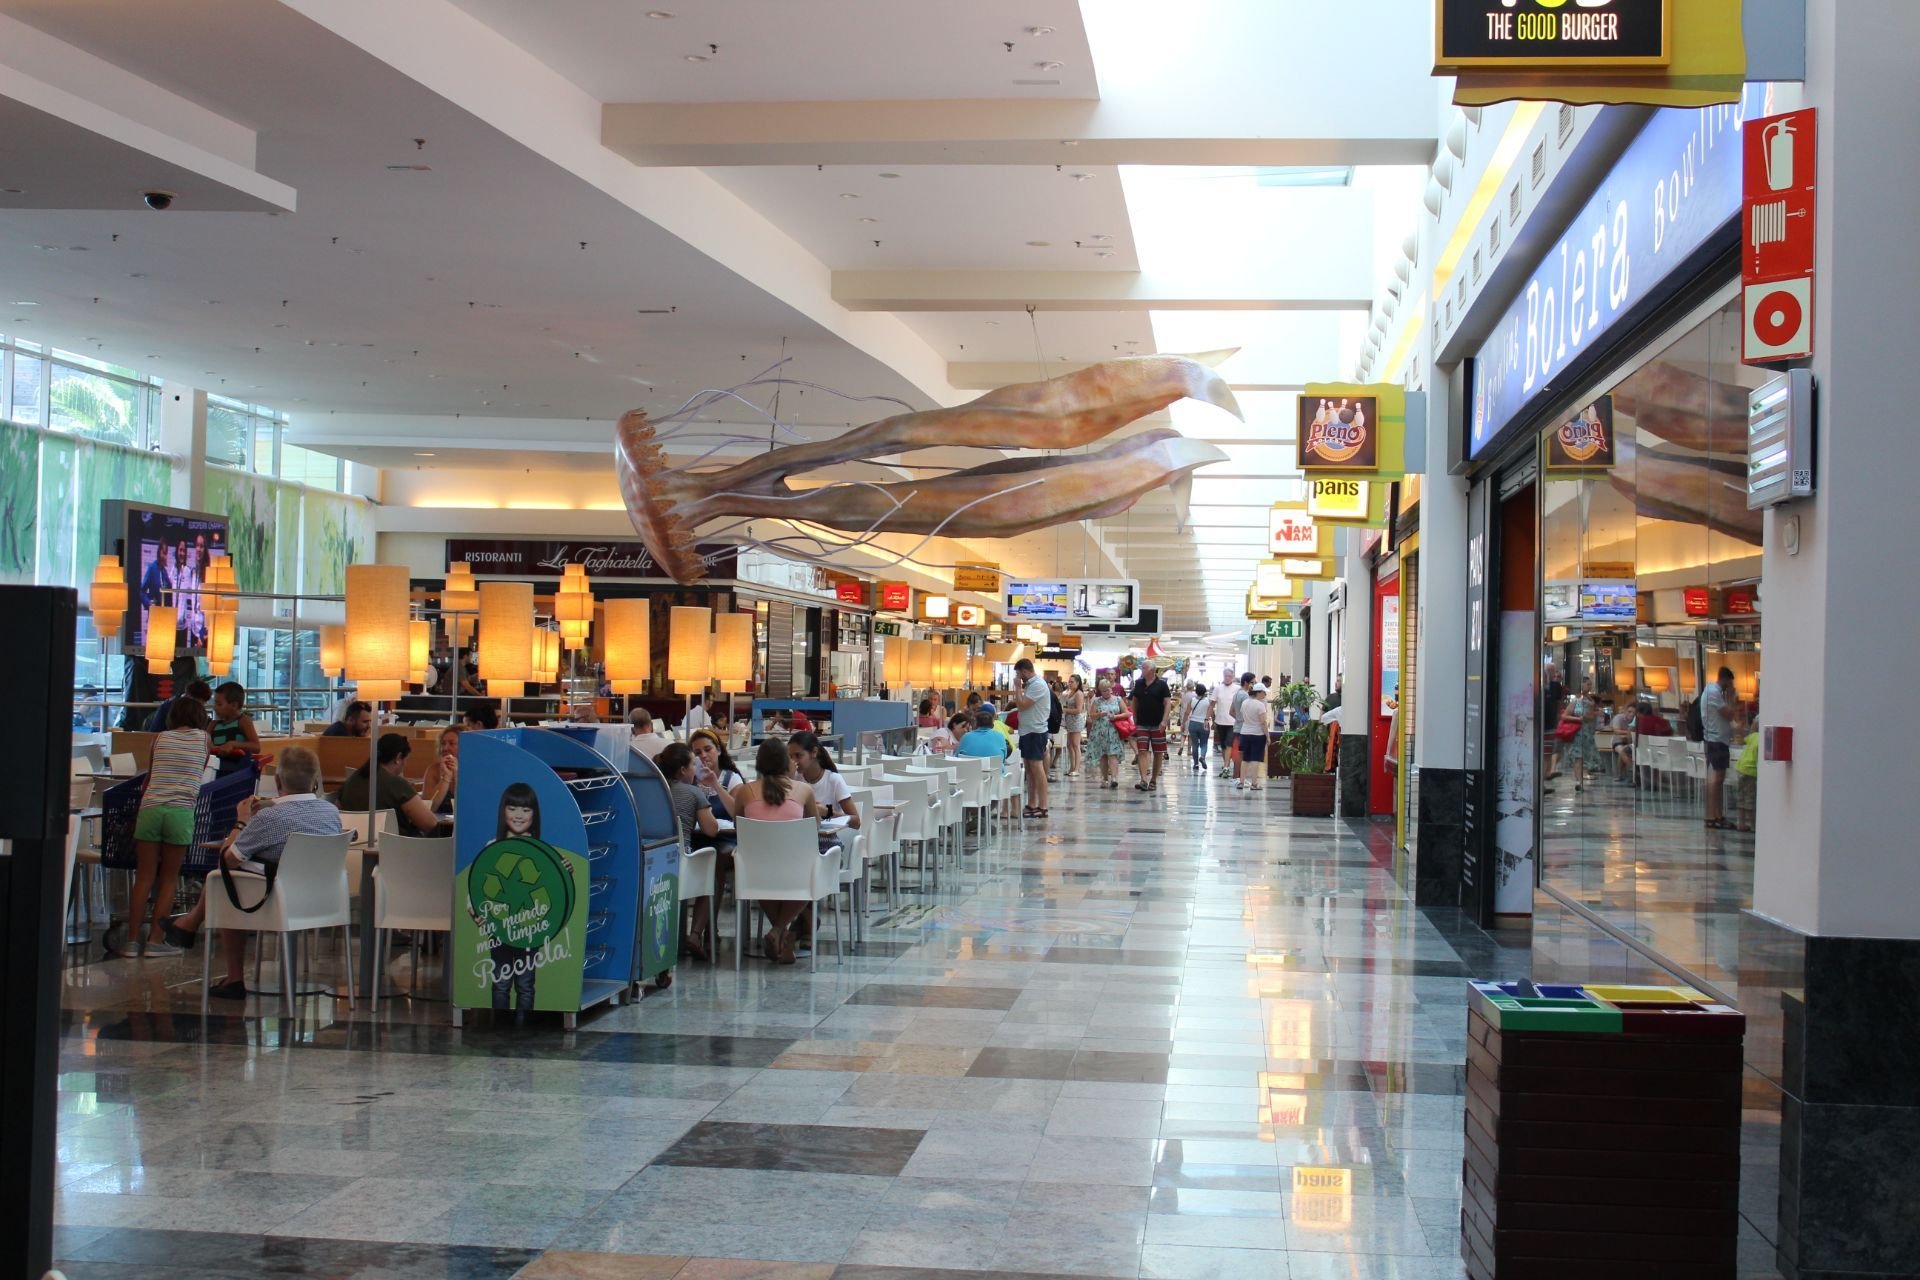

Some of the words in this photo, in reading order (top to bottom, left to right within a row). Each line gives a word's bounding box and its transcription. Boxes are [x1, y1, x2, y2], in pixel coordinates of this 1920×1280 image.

[1487, 13, 1512, 40] THE
[1517, 13, 1556, 40] GOOD
[1562, 13, 1618, 40] BURGER
[1522, 199, 1630, 395] Bolera
[1310, 423, 1360, 441] Pleno
[1313, 480, 1359, 498] pans
[465, 552, 522, 563] RISTORANTI
[537, 545, 569, 569] La
[574, 546, 652, 573] Tagliatella
[478, 922, 496, 937] un
[502, 902, 549, 925] mundo
[479, 899, 509, 919] Por
[476, 934, 502, 954] más
[507, 919, 551, 944] limpio
[472, 927, 572, 989] Recicla!
